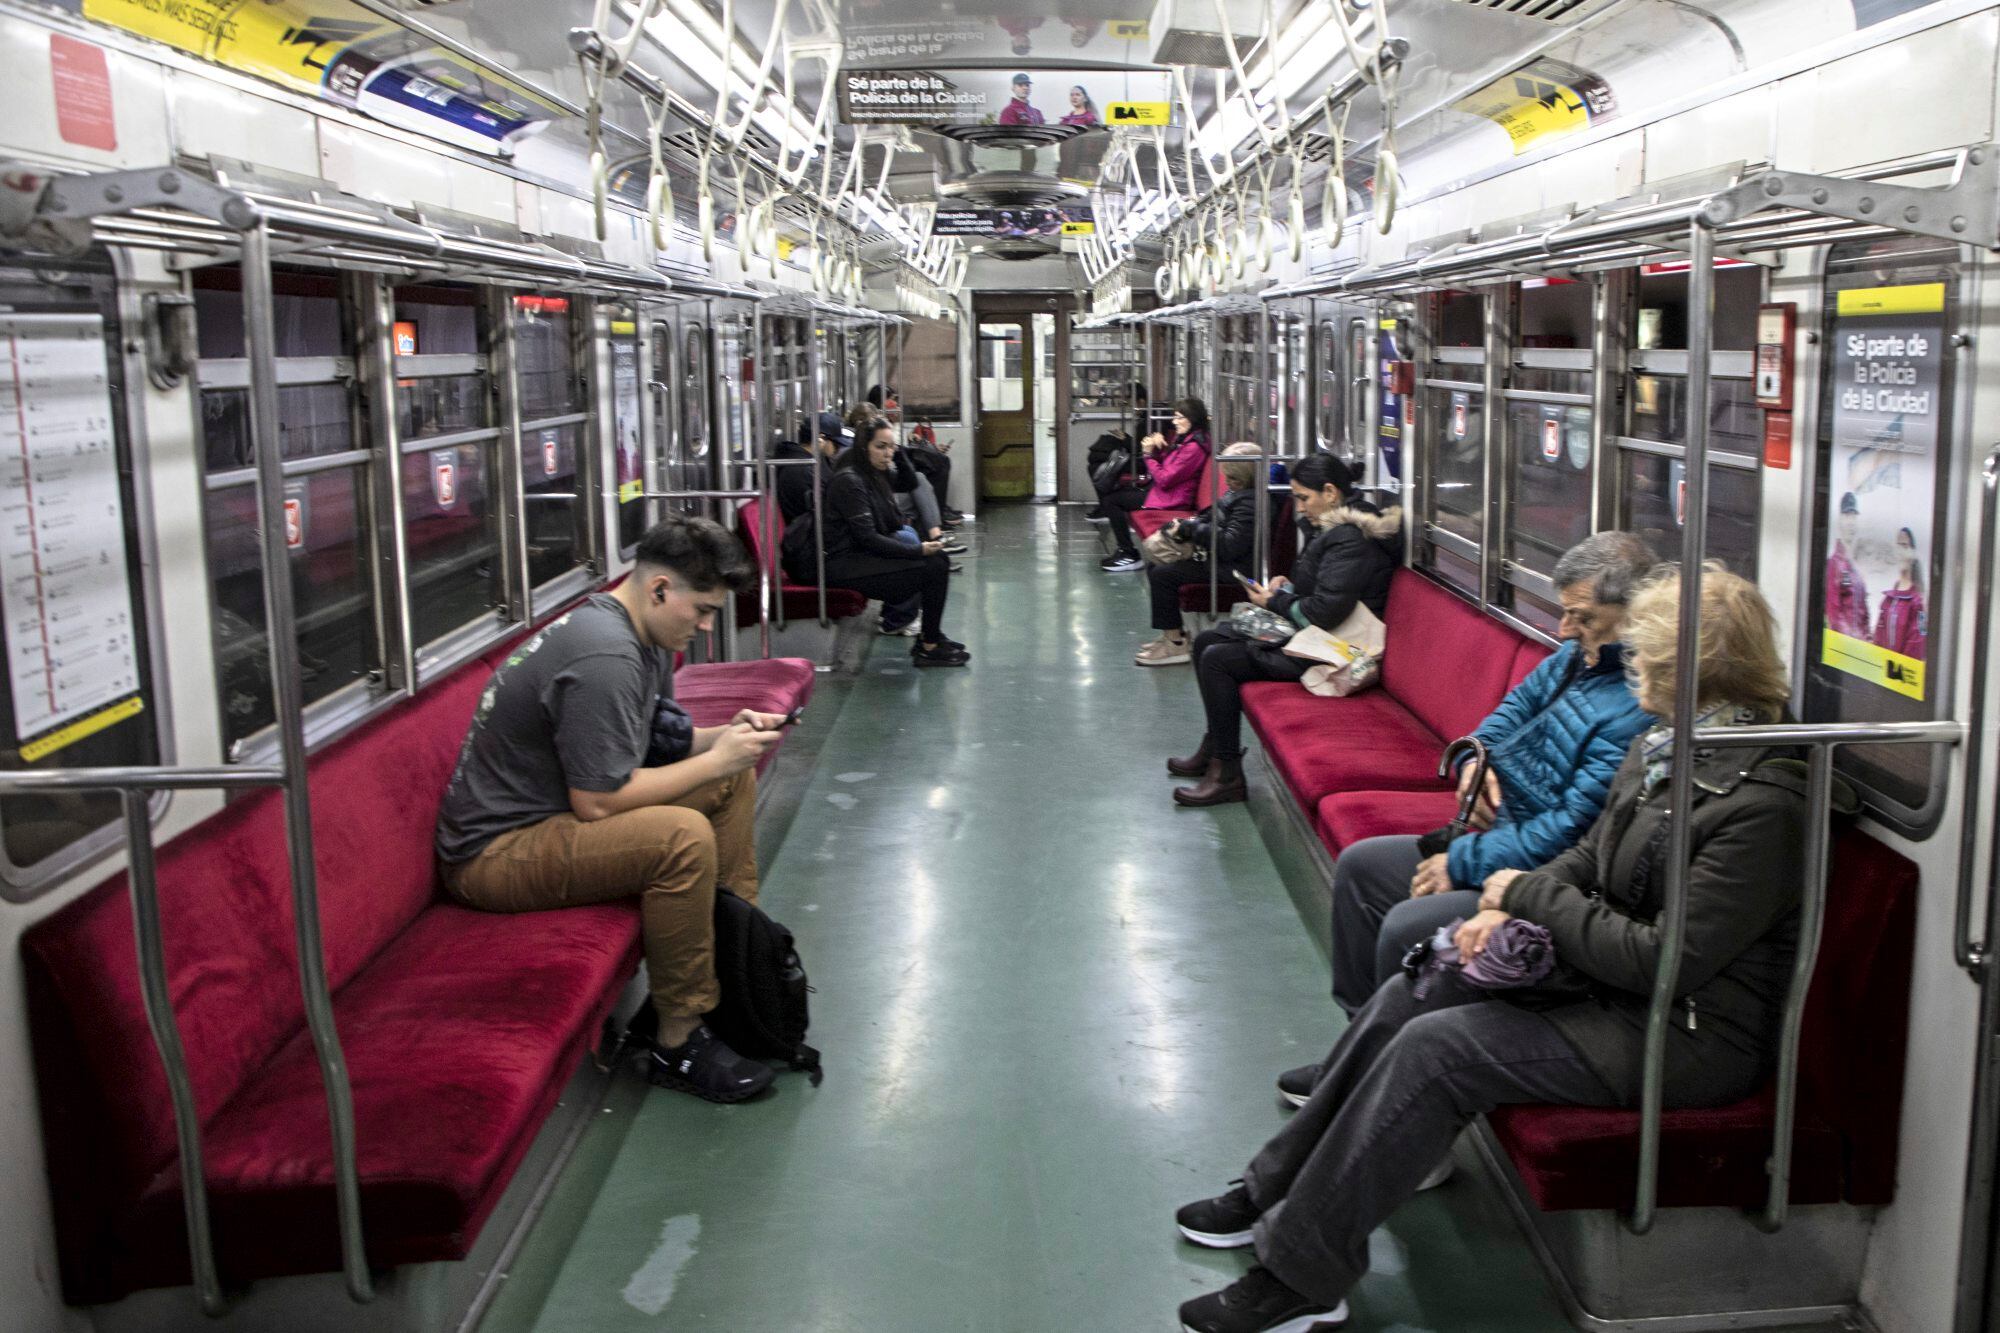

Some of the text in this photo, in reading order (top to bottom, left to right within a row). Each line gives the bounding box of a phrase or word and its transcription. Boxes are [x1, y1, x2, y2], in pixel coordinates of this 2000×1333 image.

[848, 76, 944, 91] Sé parte de la
[900, 91, 919, 104] de
[920, 91, 934, 104] la
[935, 92, 986, 104] Ciudad
[1846, 333, 1928, 361] Sé parte de
[1854, 361, 1917, 385] la Policía
[1841, 388, 1930, 414] de la Ciudad
